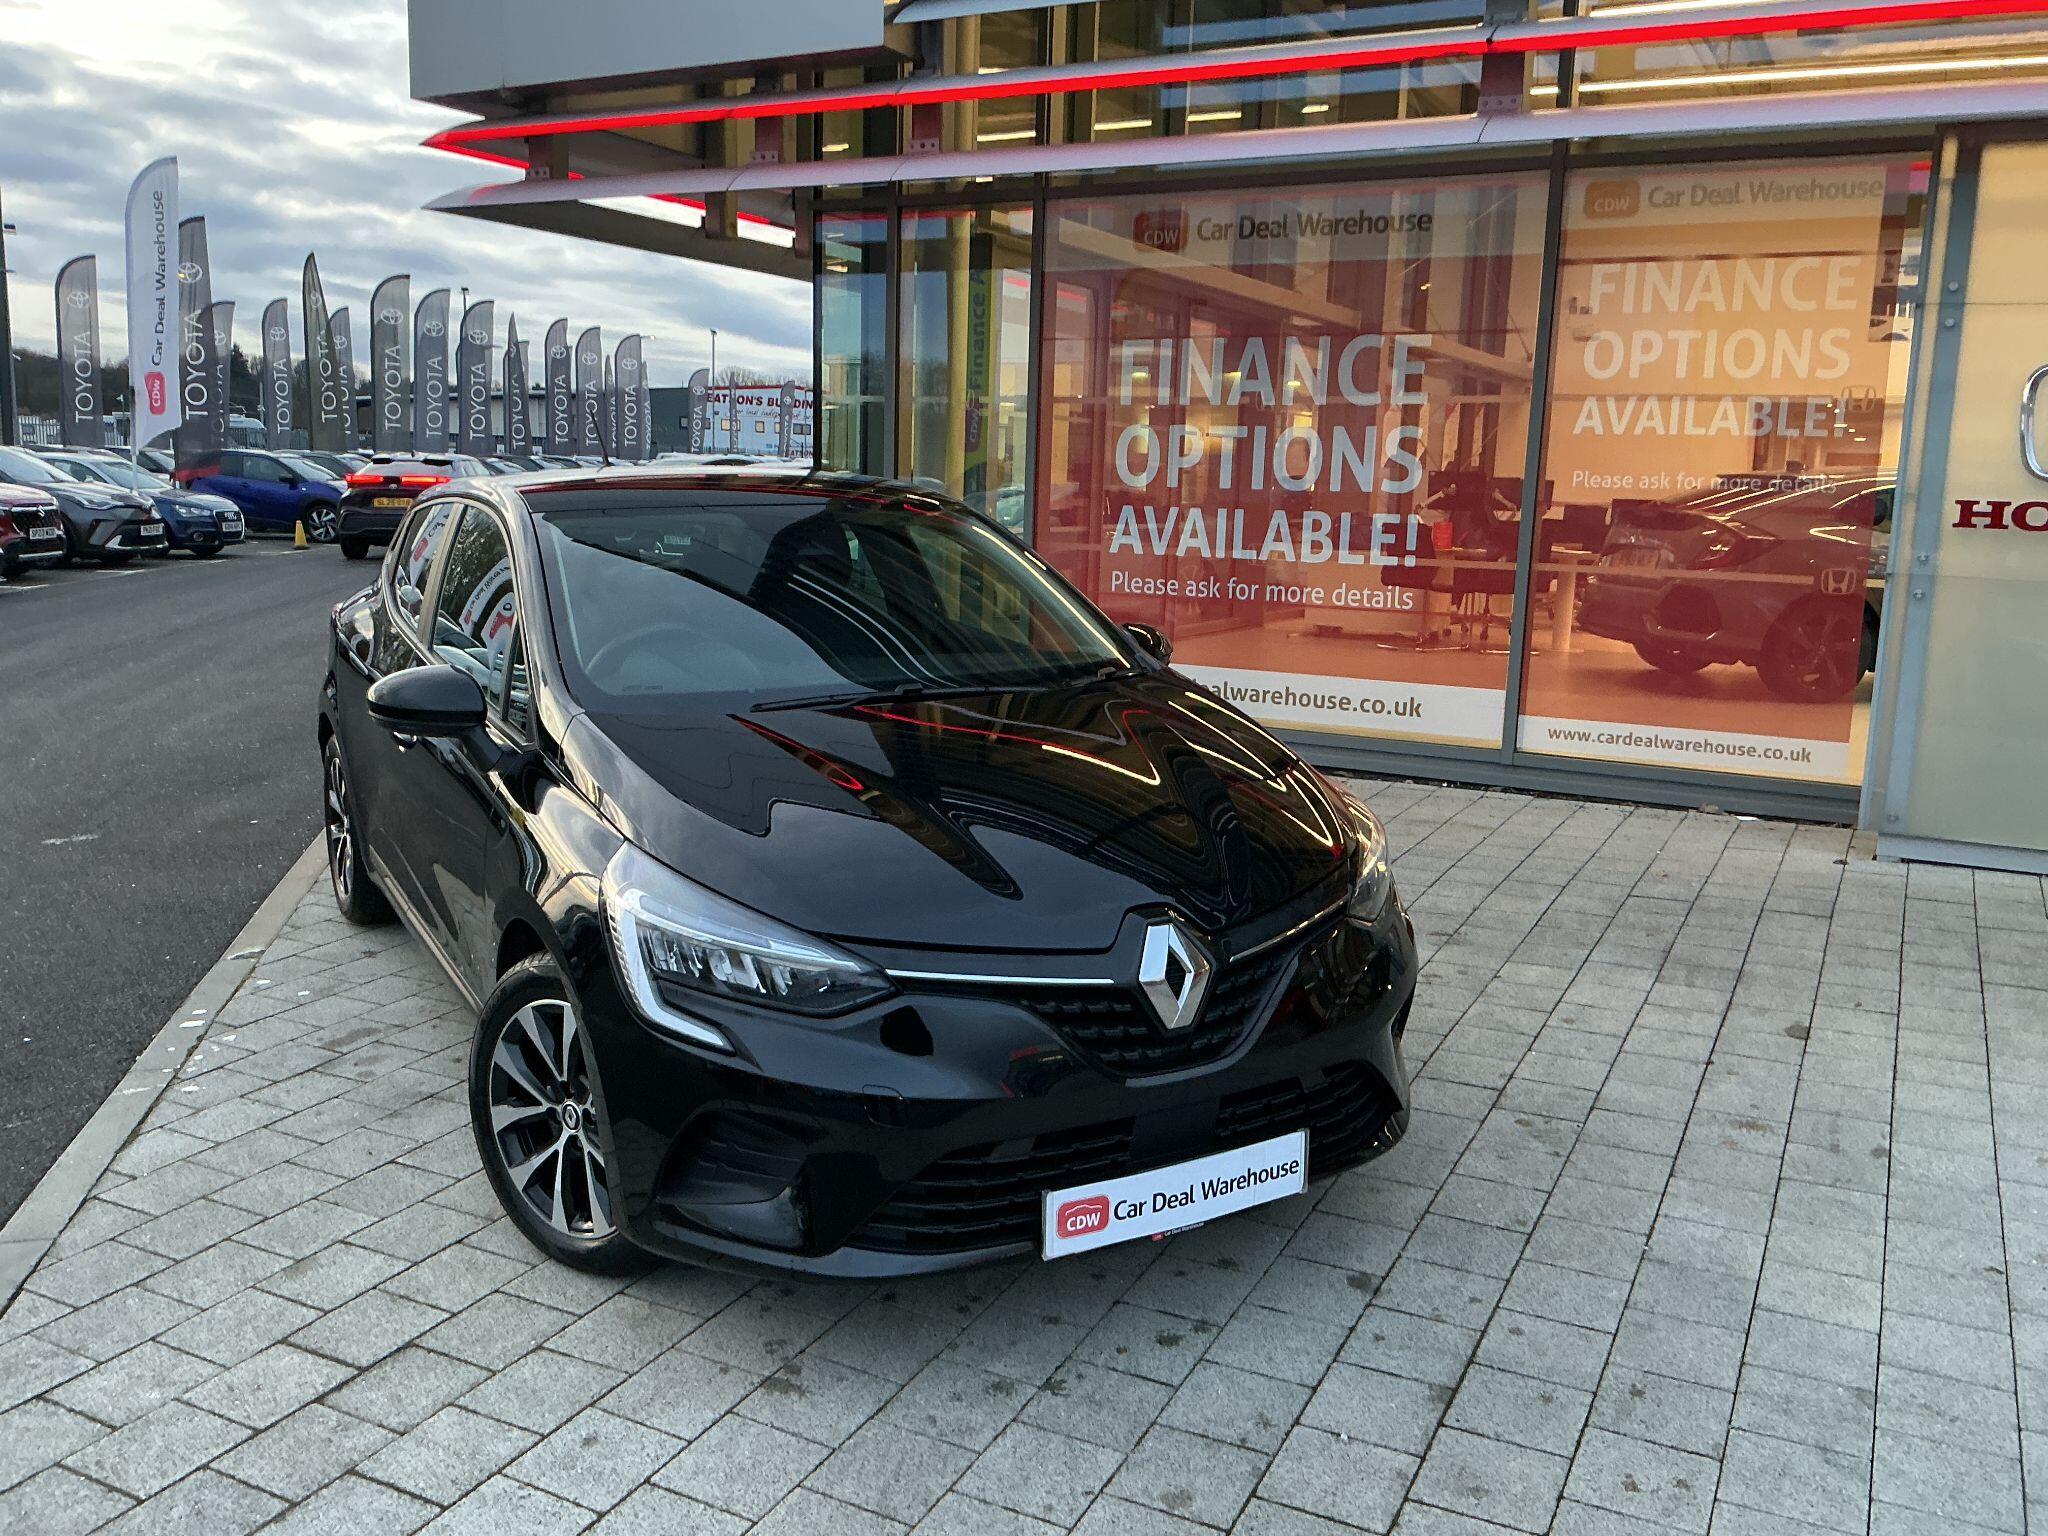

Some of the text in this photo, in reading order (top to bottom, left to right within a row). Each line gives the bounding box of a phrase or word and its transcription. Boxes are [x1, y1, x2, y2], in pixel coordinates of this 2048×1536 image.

[1594, 196, 1629, 213] CDW
[1648, 177, 1884, 209] Car Deal Warehouse
[1144, 228, 1179, 244] CDW
[1197, 210, 1433, 241] Car Deal Warehouse
[151, 190, 166, 366] Car Deal Warehouse
[1590, 257, 1862, 315] FINANCE
[74, 331, 94, 424] TOYOTA
[184, 309, 208, 421] TOYOTA
[1120, 334, 1432, 406] FINANCE
[1584, 327, 1850, 380] OPTIONS
[152, 379, 160, 406] CDW
[273, 358, 291, 434] TOYOTA
[385, 345, 401, 430] TOYOTA
[426, 356, 442, 438] TOYOTA
[470, 363, 486, 440] TOYOTA
[554, 374, 568, 445] TOYOTA
[585, 380, 598, 446] TOYOTA
[624, 384, 637, 447] TOYOTA
[707, 393, 813, 409] EATON'S BUDIN
[1572, 395, 1847, 438] AVAILABLE!
[692, 405, 703, 453] TOYOTA
[1116, 424, 1423, 493] OPTIONS
[1572, 470, 1837, 494] Please ask for more details
[1109, 505, 1419, 567] AVAILABLE!
[1111, 571, 1413, 610] Please ask for more details
[1193, 679, 1423, 718] alwarehouse.co.uk
[1547, 726, 1812, 763] www.cardealwarehouse.co.uk
[1113, 1159, 1299, 1220] Car Deal Warehouse
[1066, 1212, 1101, 1231] CDW
